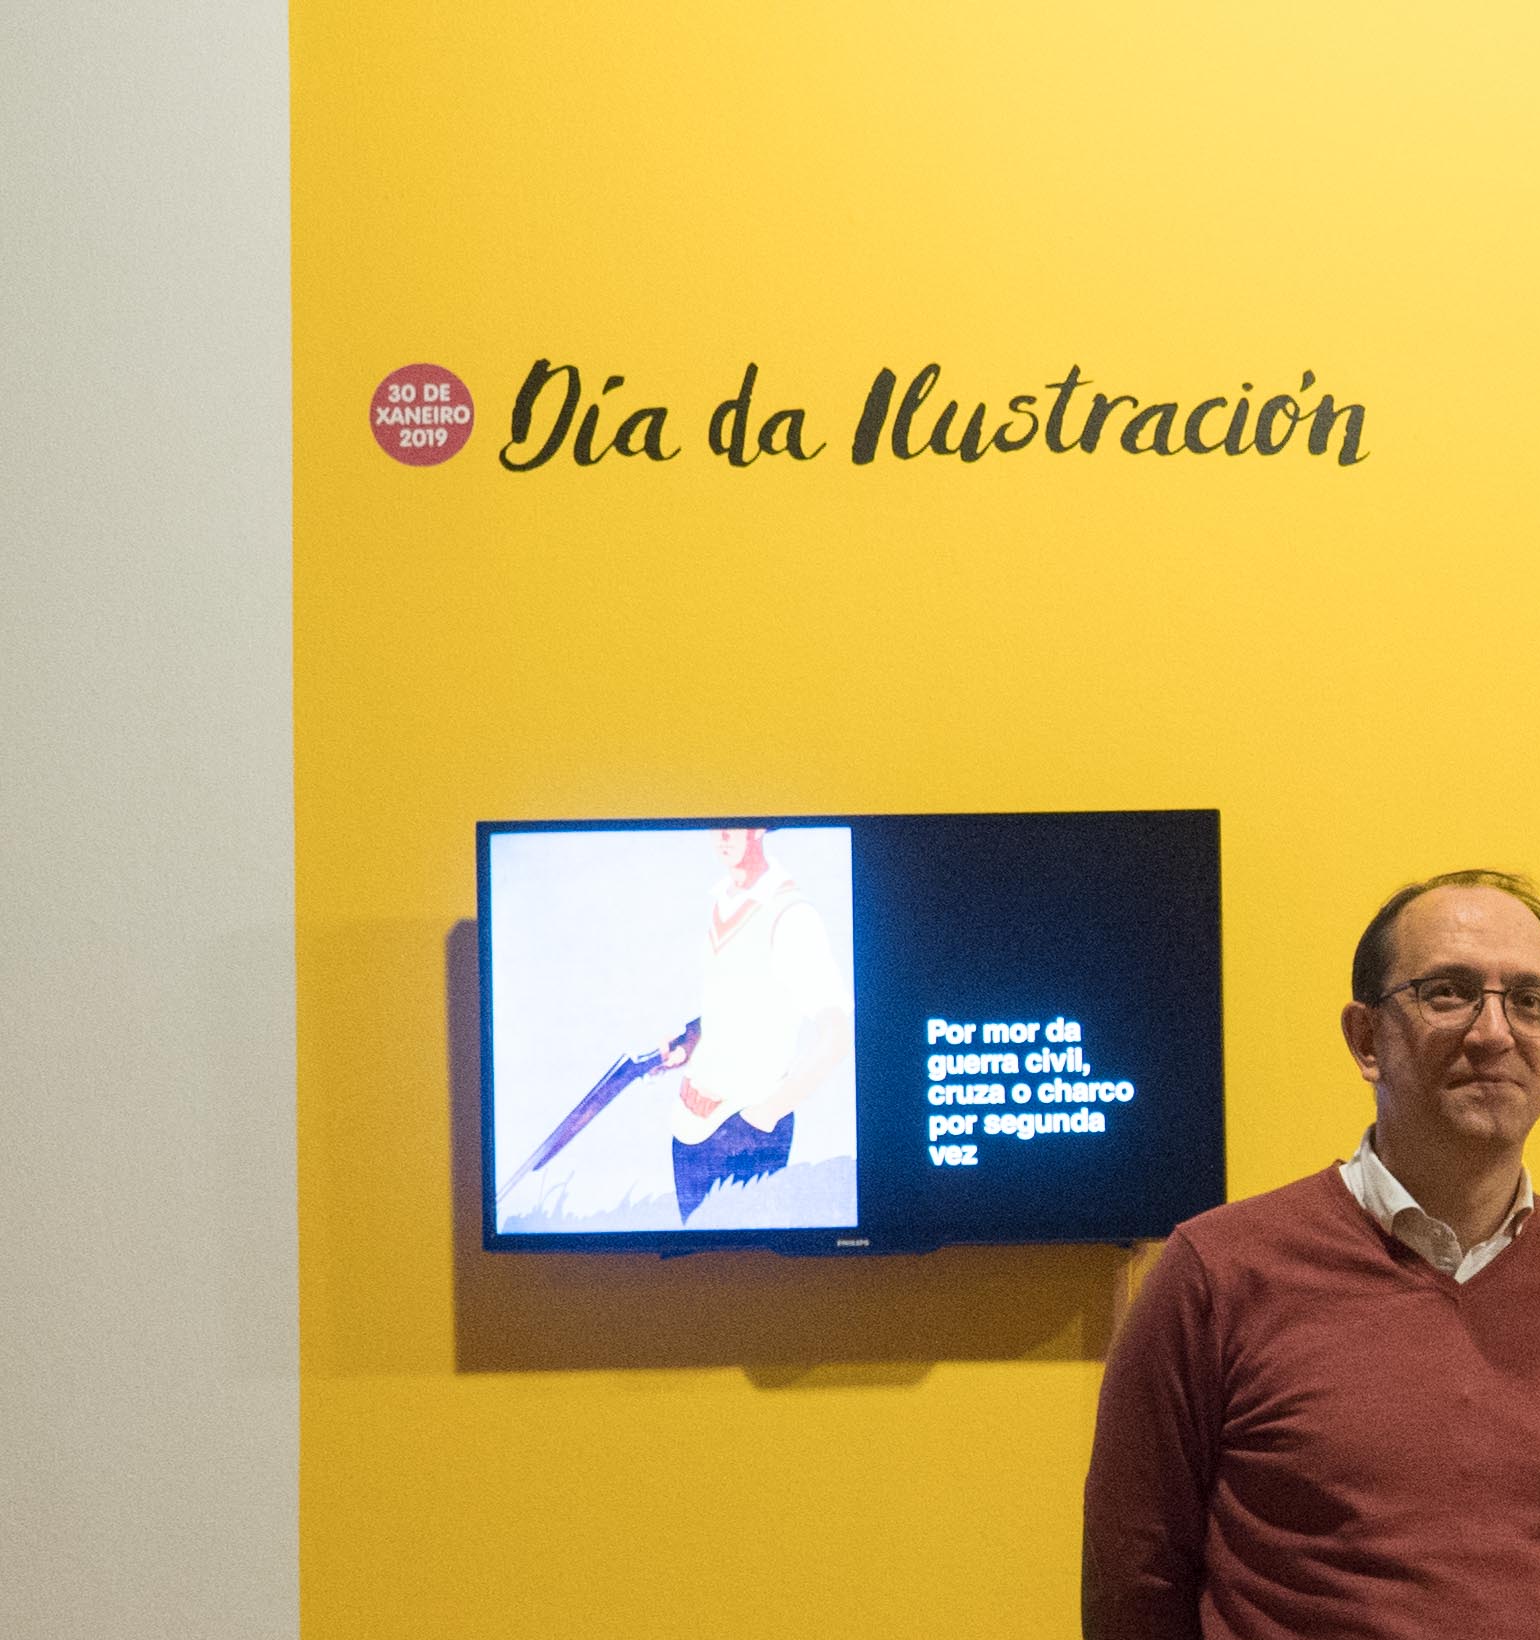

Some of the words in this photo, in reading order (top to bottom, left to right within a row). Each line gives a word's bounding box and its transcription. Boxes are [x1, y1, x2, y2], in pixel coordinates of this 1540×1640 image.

[387, 383, 417, 404] 30
[422, 382, 451, 403] DE
[375, 404, 471, 427] XANEIRO
[498, 357, 682, 473] Día
[708, 362, 828, 468] da
[851, 362, 1371, 467] Ilustración
[398, 427, 449, 448] 2019
[926, 1018, 977, 1046] Por
[982, 1020, 1041, 1045] mor
[1044, 1016, 1082, 1044] da
[926, 1052, 1020, 1081] guerra
[1024, 1046, 1091, 1077] civil,
[926, 1082, 1006, 1106] cruza
[1010, 1082, 1033, 1105] o
[1036, 1077, 1136, 1105] charco
[928, 1113, 978, 1142] por
[983, 1107, 1106, 1140] segunda
[927, 1143, 979, 1167] vez
